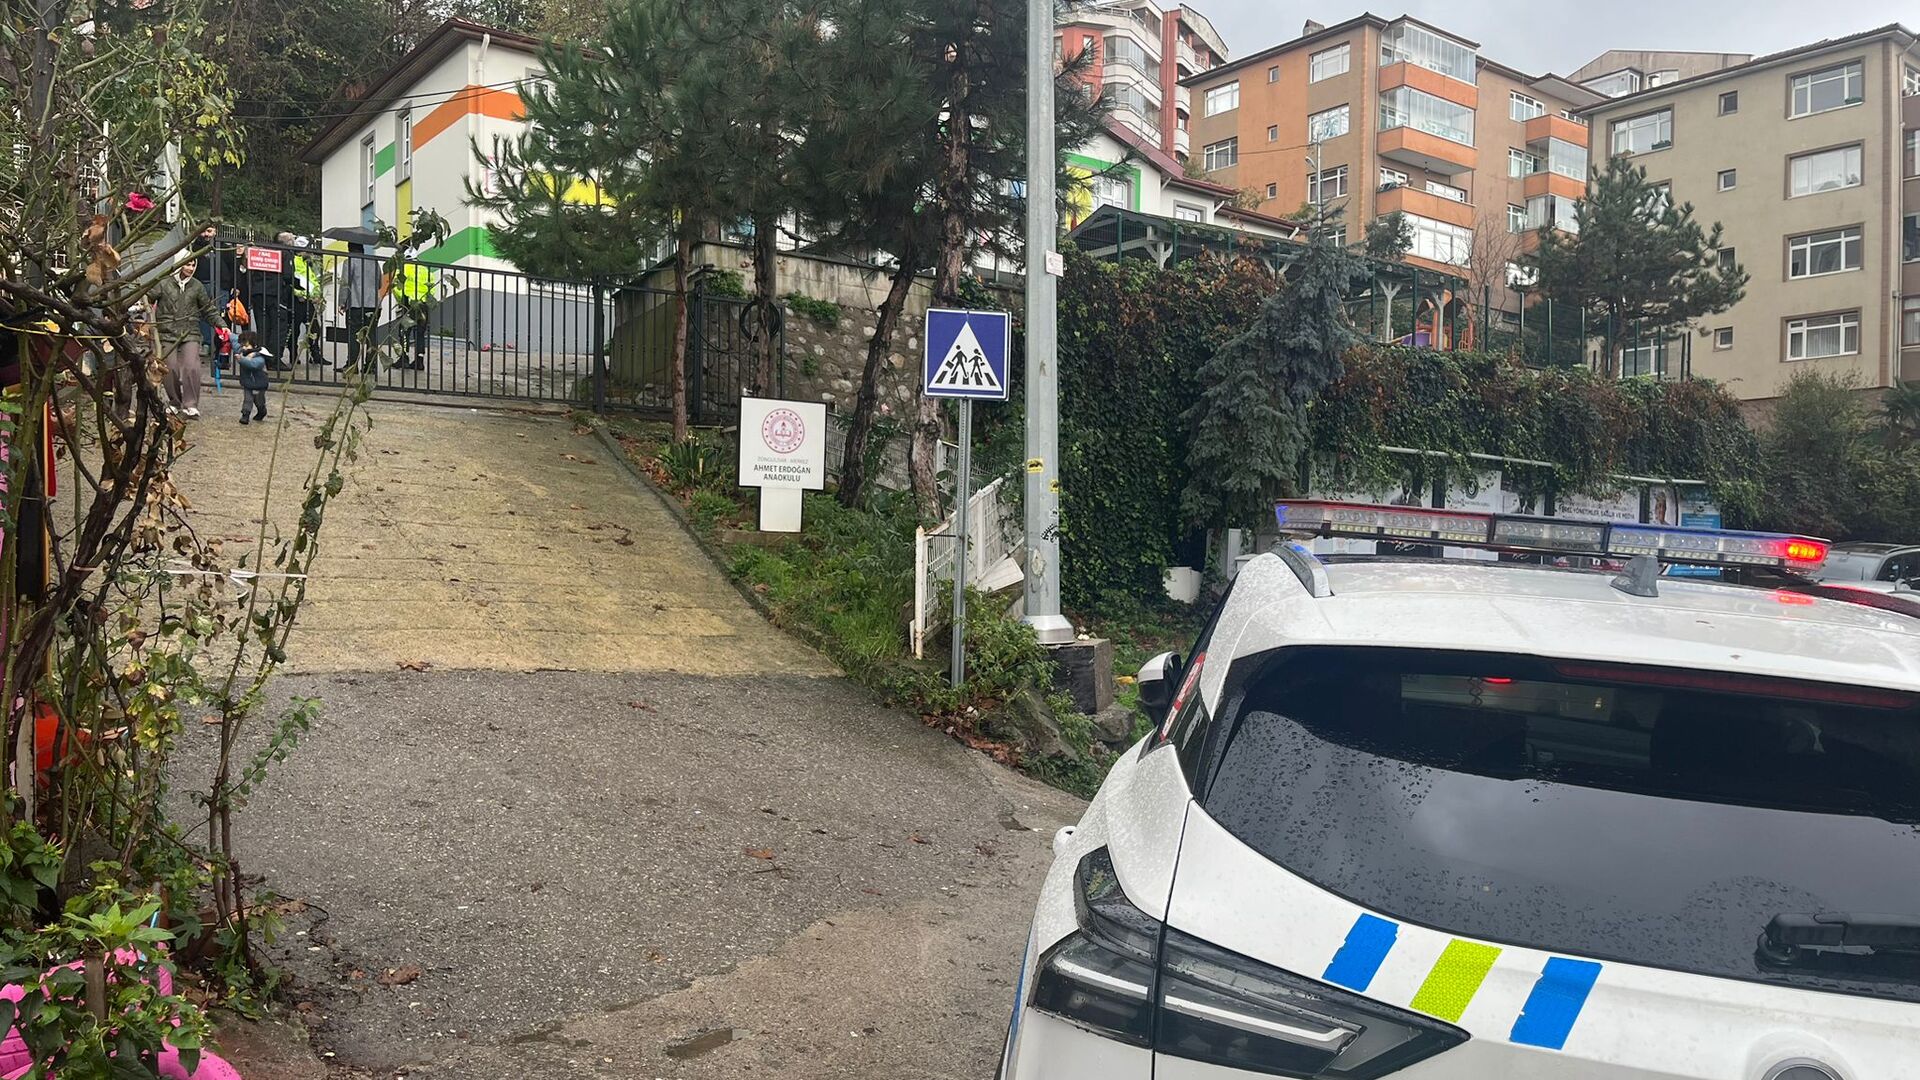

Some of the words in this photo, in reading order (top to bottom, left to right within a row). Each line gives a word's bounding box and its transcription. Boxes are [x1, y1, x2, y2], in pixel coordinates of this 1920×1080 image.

[753, 464, 777, 473] AHMET
[778, 465, 811, 474] ERDOĞAN
[763, 473, 801, 481] ANAOKULU
